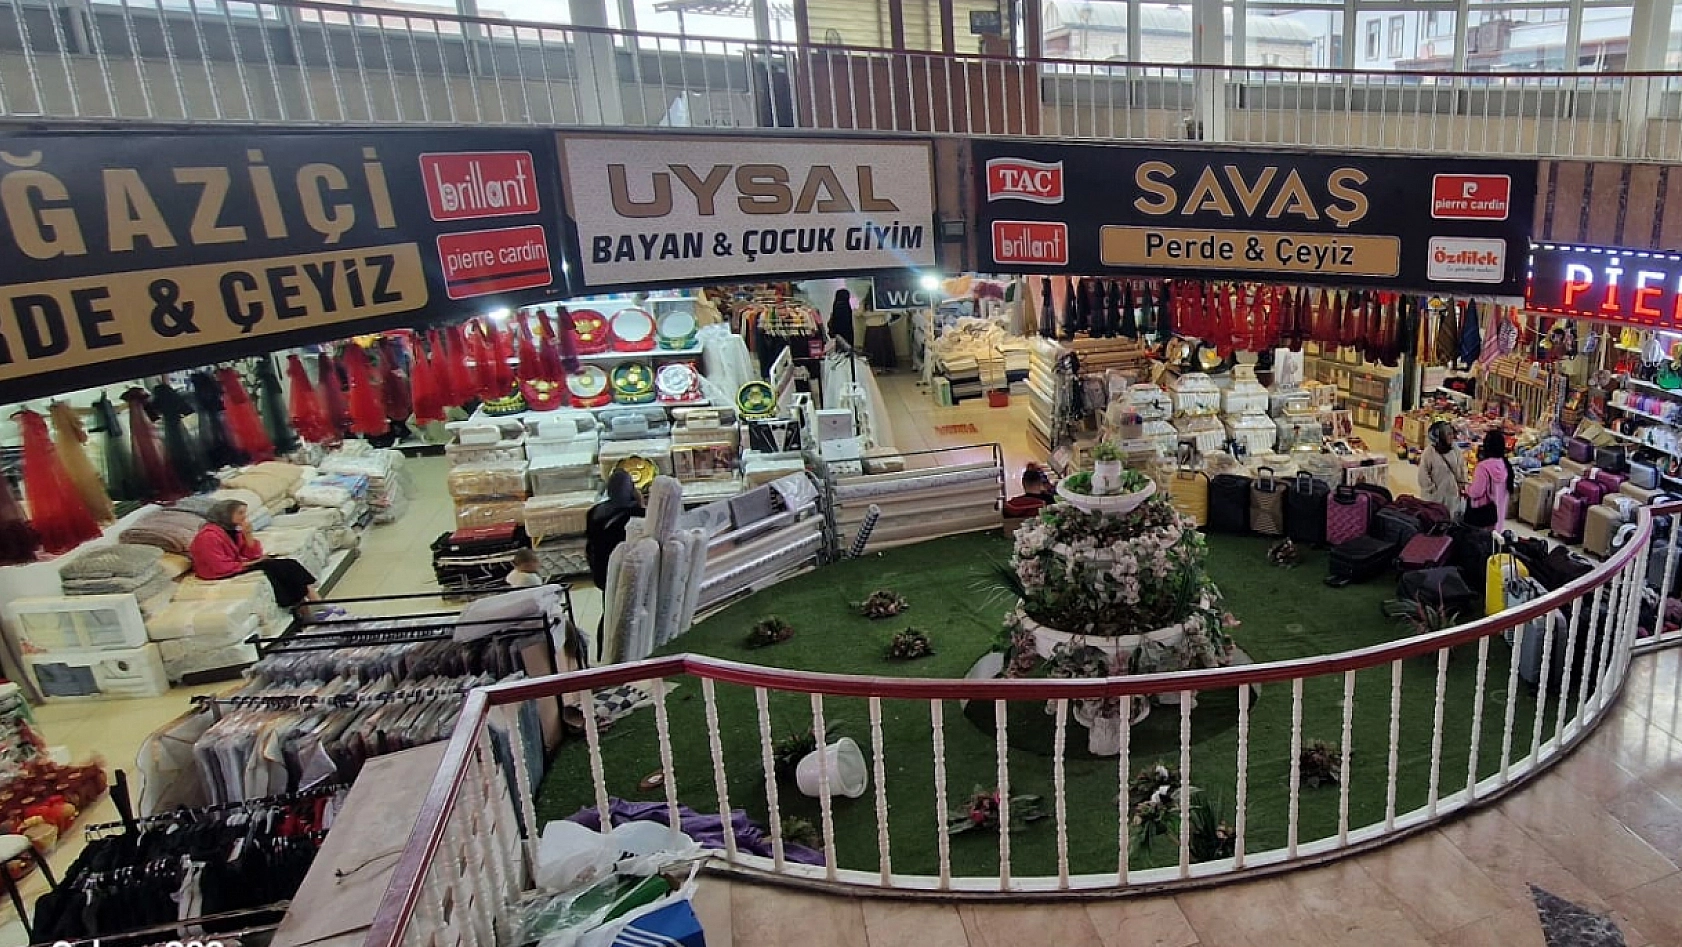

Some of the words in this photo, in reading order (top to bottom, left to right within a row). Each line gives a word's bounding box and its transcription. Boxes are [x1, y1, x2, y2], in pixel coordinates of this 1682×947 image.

[433, 159, 528, 212] brillant
[607, 163, 900, 218] UYSAL
[999, 169, 1052, 196] TAÇ
[1132, 160, 1369, 227] SAVAŞ
[1435, 198, 1468, 210] pierre
[1470, 198, 1505, 211] cardin
[447, 248, 495, 276] pierre
[498, 240, 546, 265] cardin
[592, 231, 703, 264] BAYAN
[713, 234, 733, 257] &
[741, 227, 835, 263] ÇOCUK
[845, 220, 924, 253] GİYİM
[1000, 227, 1061, 259] brillant
[1145, 231, 1236, 263] Perde
[1244, 236, 1266, 263] &
[1275, 236, 1354, 272] Çeyiz
[0, 286, 123, 365] DE
[148, 278, 200, 338] &
[218, 255, 403, 333] ÇEYİZ
[887, 290, 925, 306] WC
